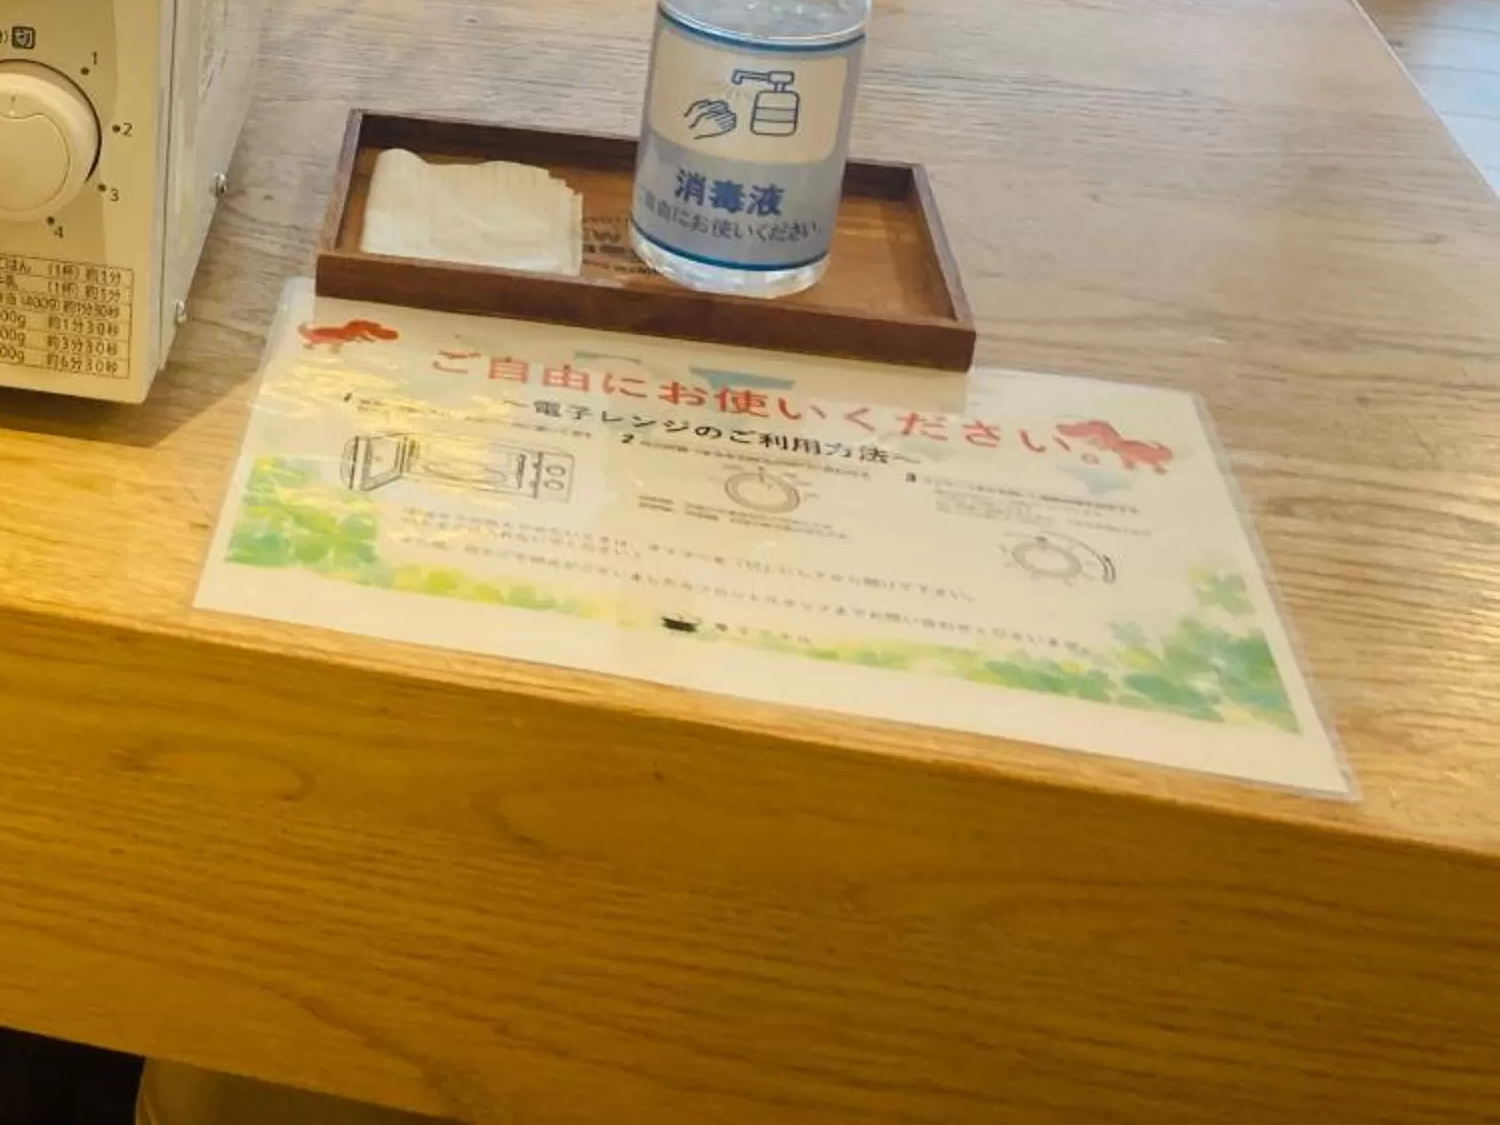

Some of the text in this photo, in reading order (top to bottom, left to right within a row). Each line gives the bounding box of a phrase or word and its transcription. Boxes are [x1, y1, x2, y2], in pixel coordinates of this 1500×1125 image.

[90, 51, 99, 66] 1
[123, 123, 133, 137] 2
[110, 188, 120, 202] 3
[673, 167, 786, 217] 消毒液
[53, 224, 65, 240] 4
